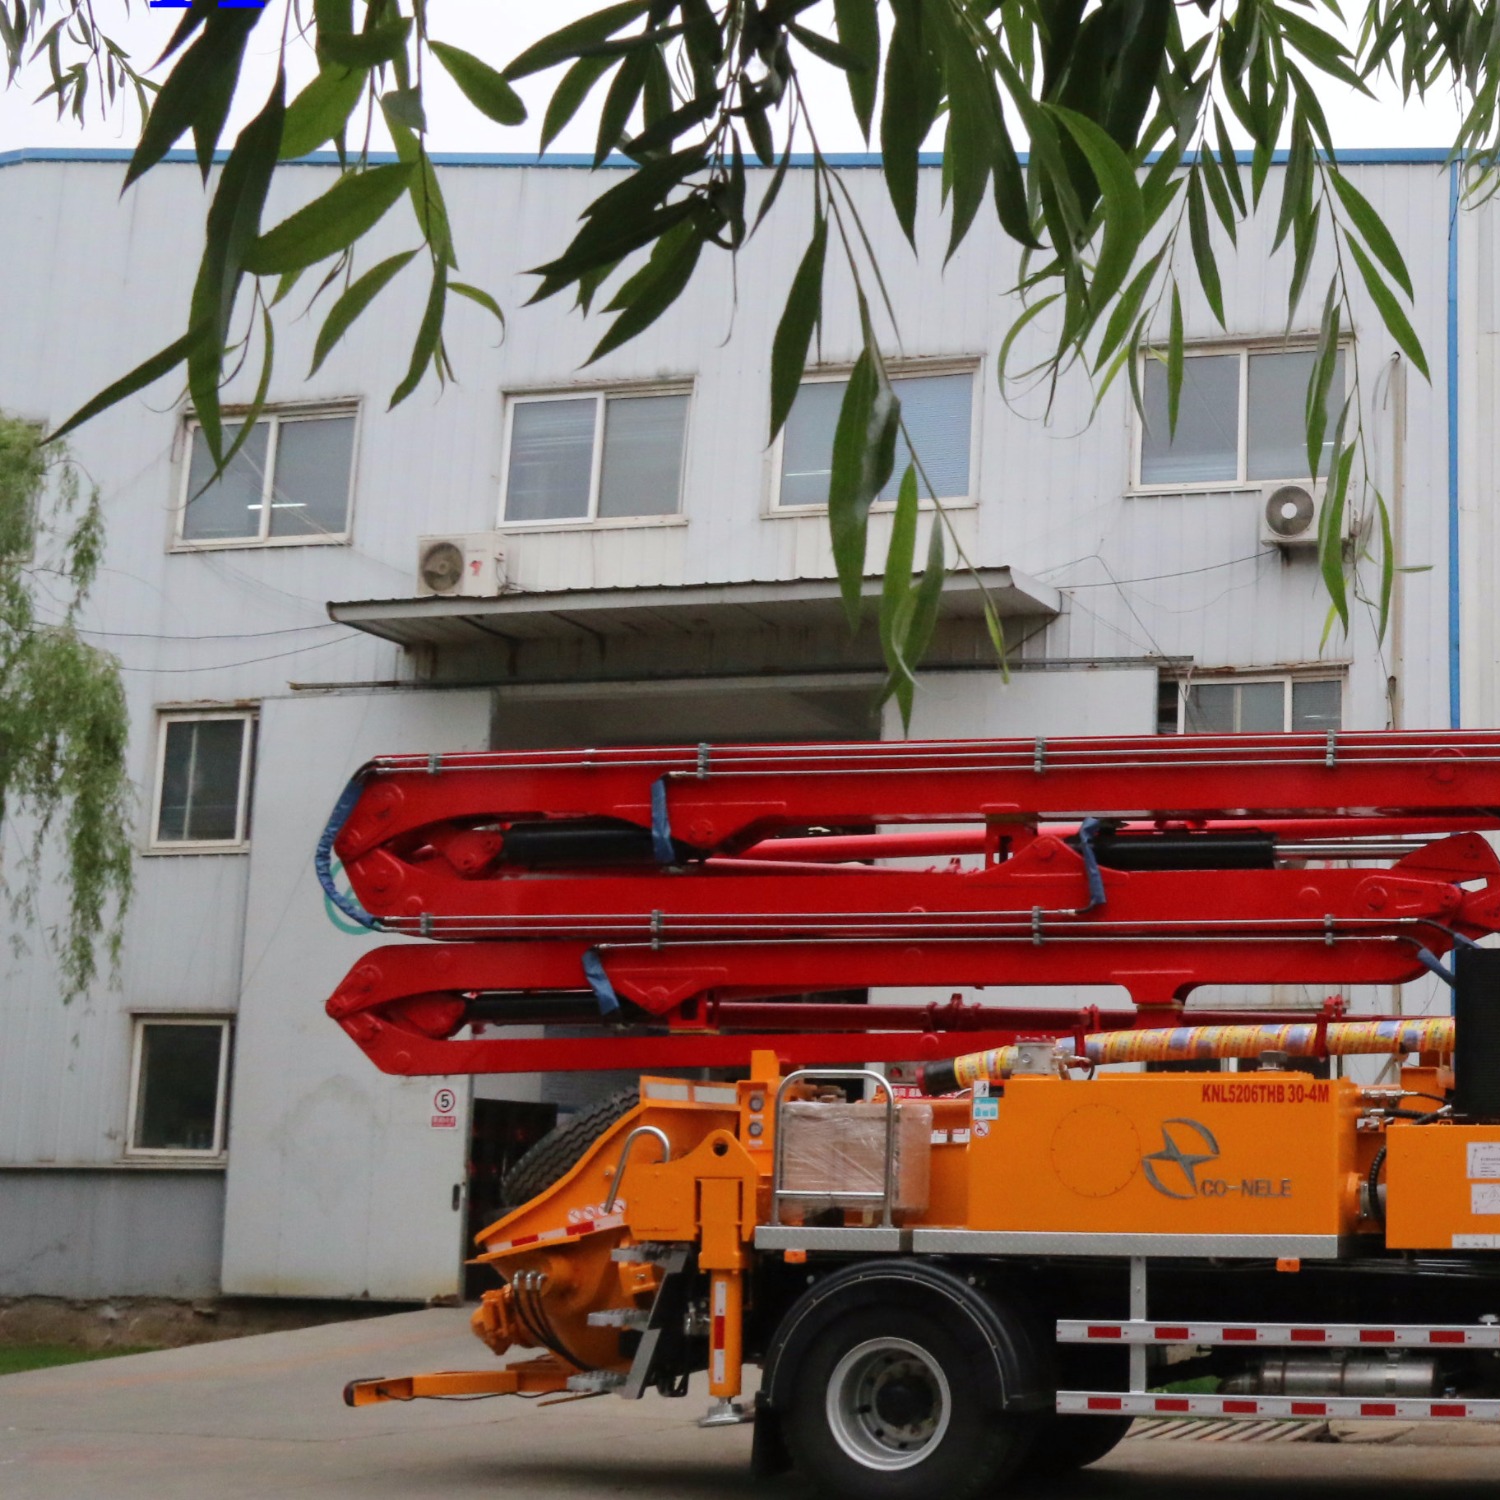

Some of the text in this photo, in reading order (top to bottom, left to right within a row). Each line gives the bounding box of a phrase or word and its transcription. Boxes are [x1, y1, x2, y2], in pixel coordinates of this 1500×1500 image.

[441, 1094, 450, 1108] 5
[1201, 1084, 1330, 1103] KNL5206THB 30-4M
[1201, 1179, 1292, 1197] CO-NELE
